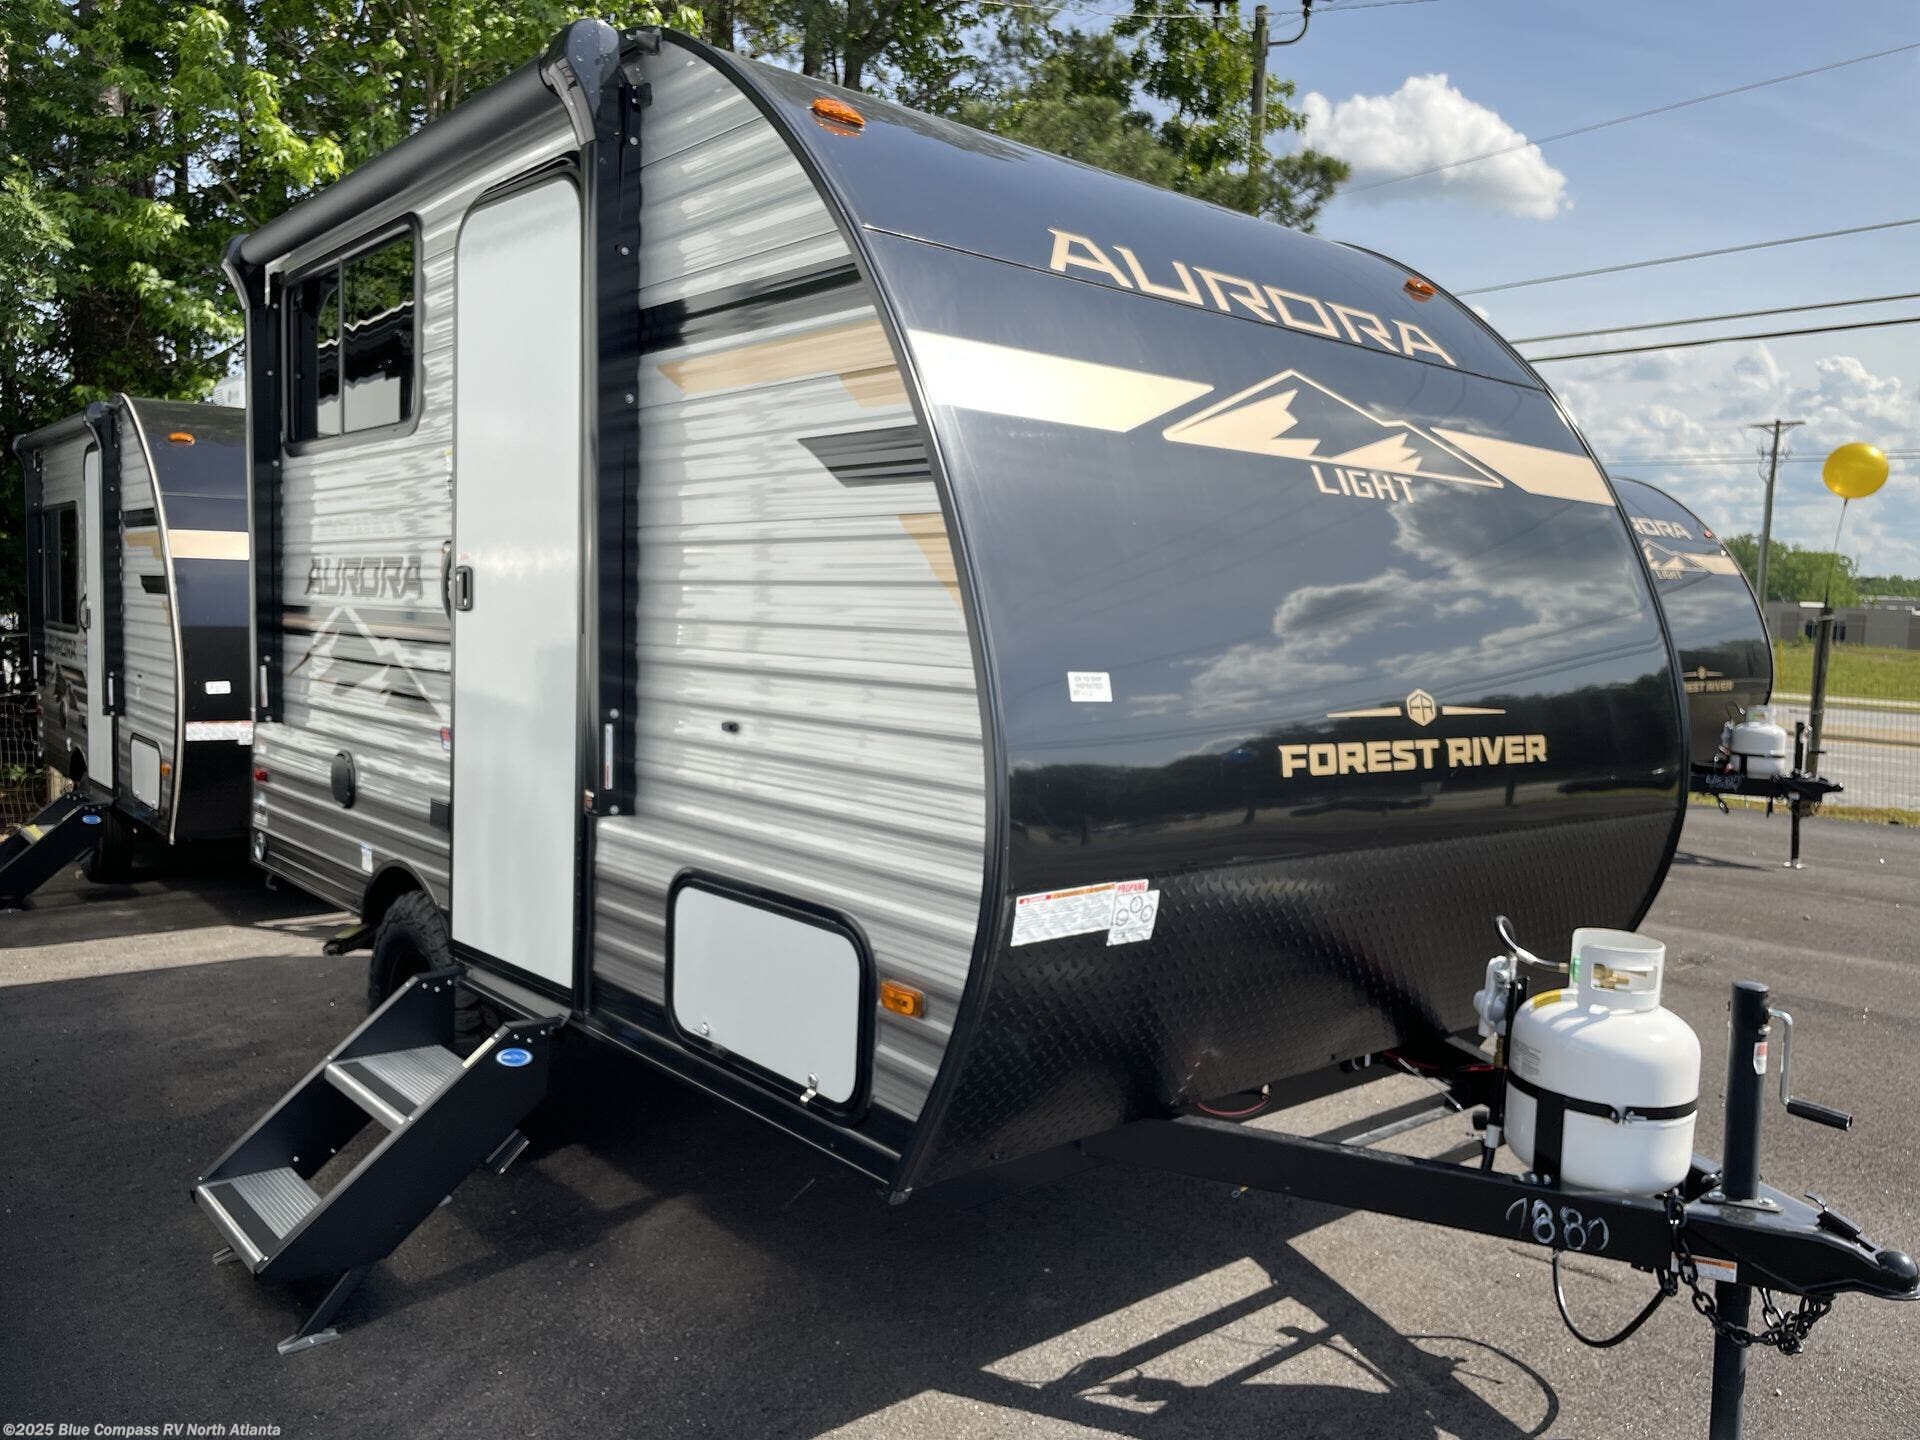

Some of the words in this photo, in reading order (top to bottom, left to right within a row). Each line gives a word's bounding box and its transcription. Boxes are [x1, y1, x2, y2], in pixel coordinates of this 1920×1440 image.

[1048, 228, 1457, 366] AURORA
[1311, 464, 1414, 503] LIGHT
[304, 556, 424, 600] AURORA
[1278, 738, 1440, 778] FOREST
[1445, 734, 1549, 769] RIVER
